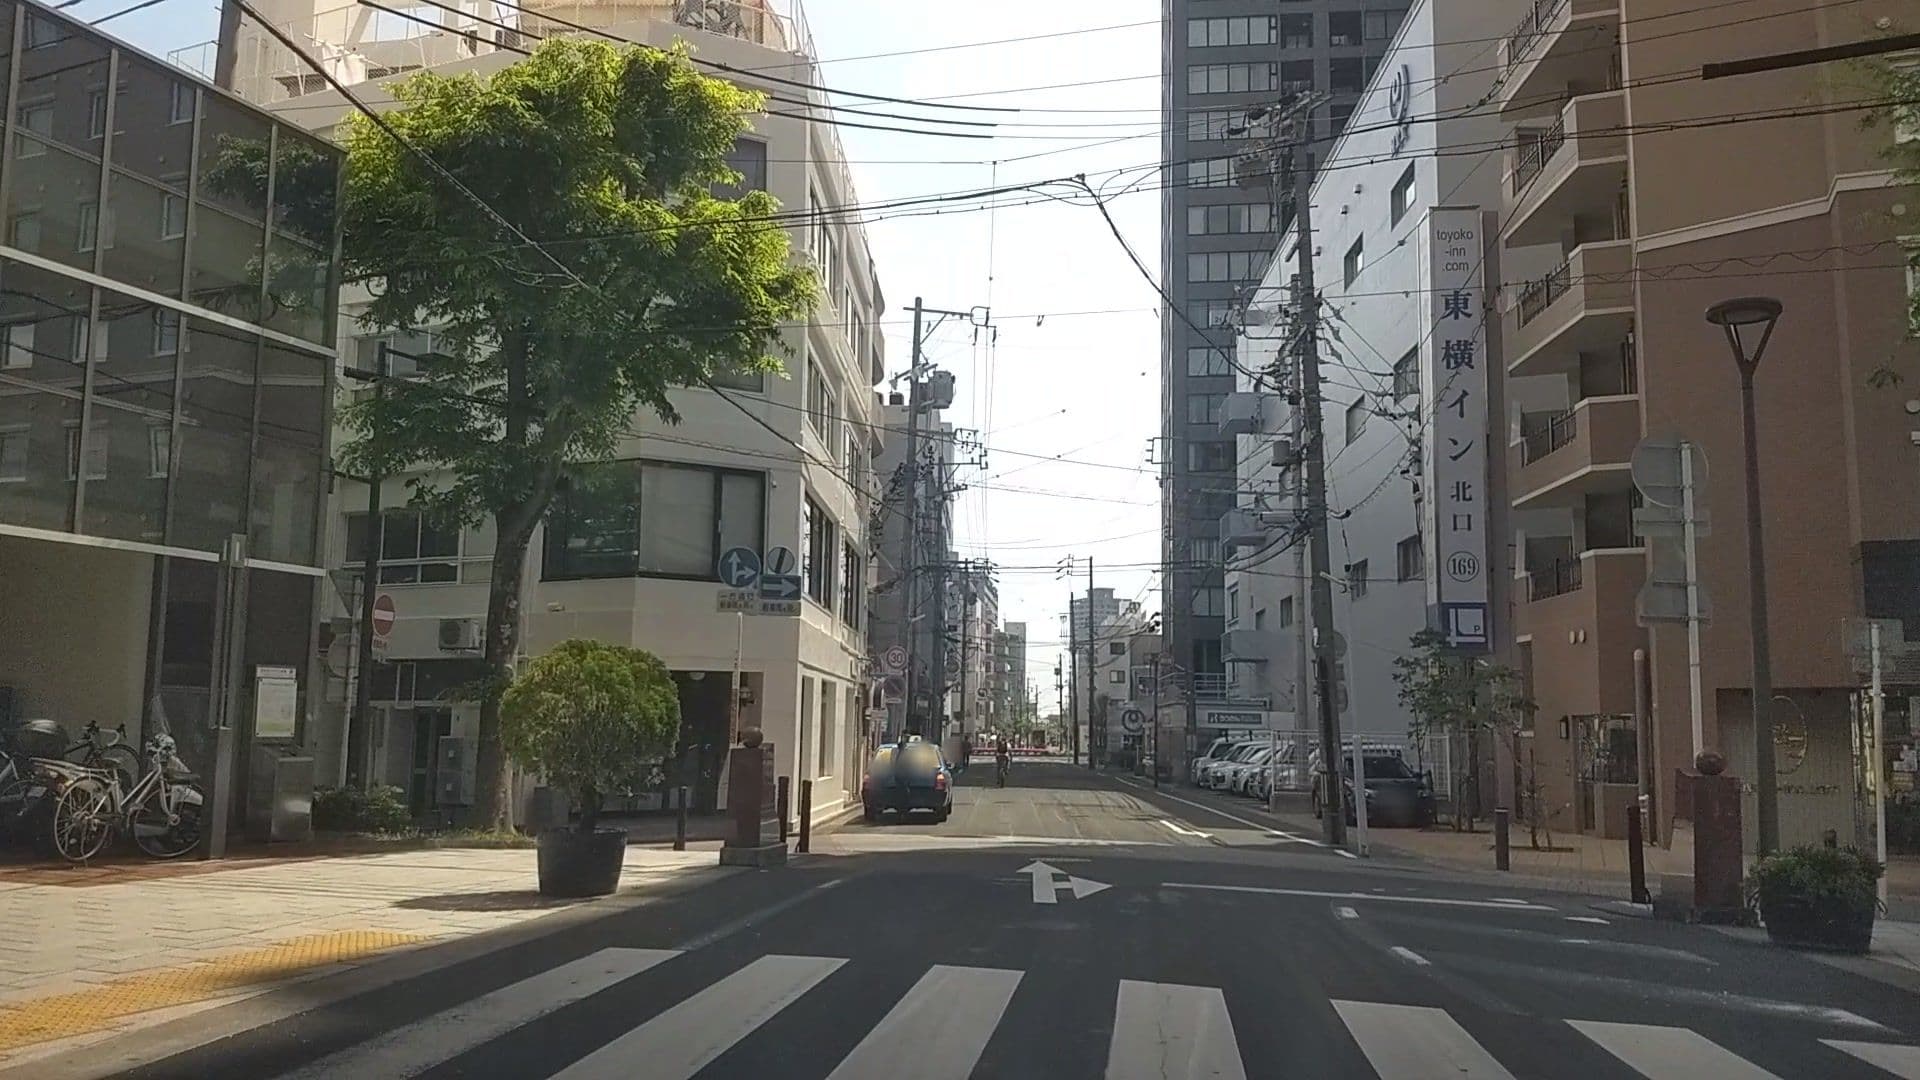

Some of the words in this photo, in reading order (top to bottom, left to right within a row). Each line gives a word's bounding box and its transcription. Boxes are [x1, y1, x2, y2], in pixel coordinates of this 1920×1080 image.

[1437, 228, 1473, 243] toyoko
[1444, 246, 1466, 257] -inn
[1442, 262, 1469, 272] .com
[1452, 558, 1476, 576] 169
[1474, 625, 1480, 633] P
[891, 652, 903, 663] 30
